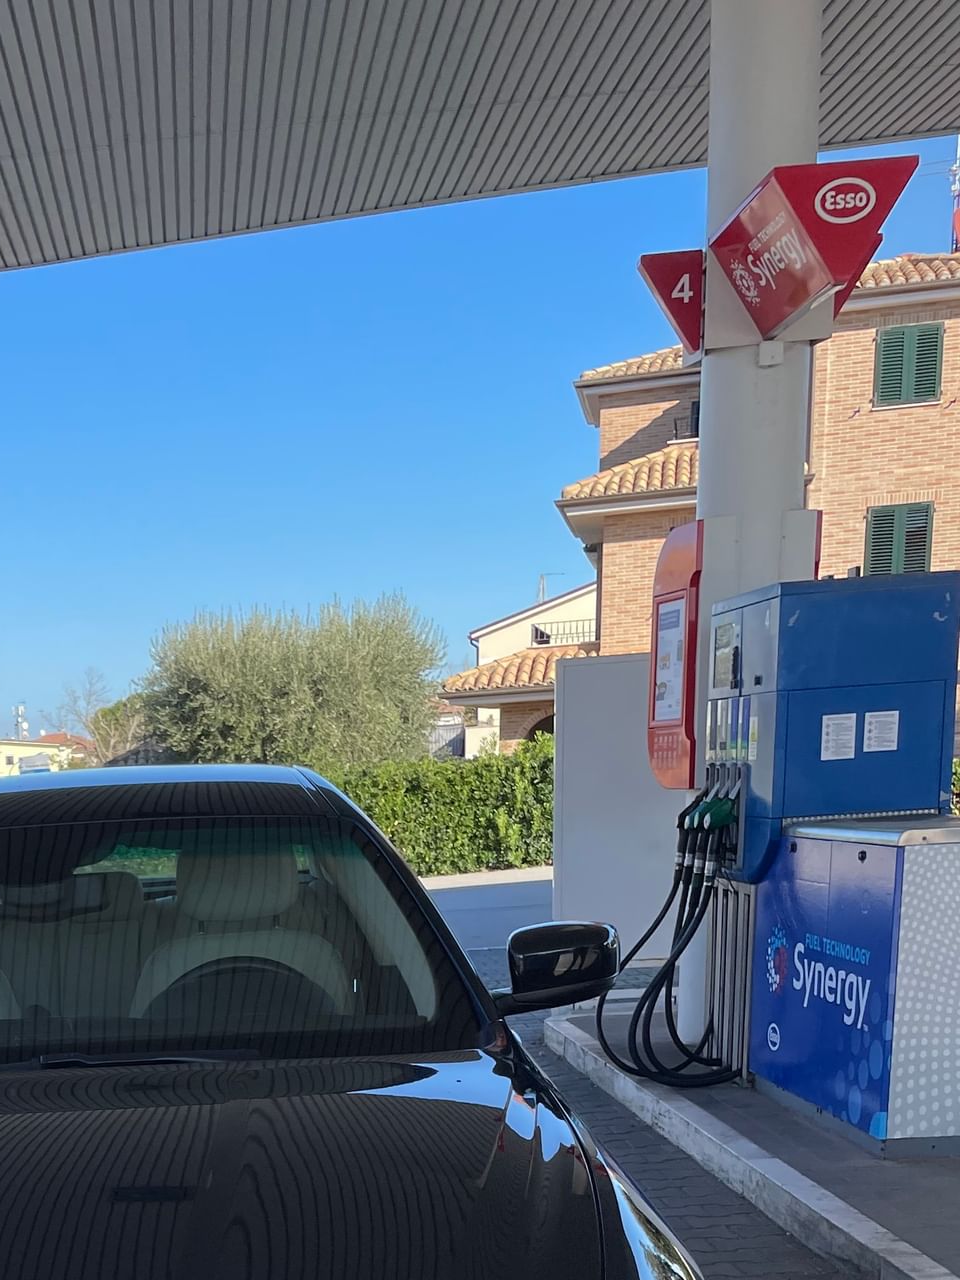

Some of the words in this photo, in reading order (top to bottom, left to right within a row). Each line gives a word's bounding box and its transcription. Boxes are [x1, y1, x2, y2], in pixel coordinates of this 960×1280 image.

[825, 190, 867, 210] Esso
[747, 228, 807, 290] Synergy
[671, 273, 693, 303] 4
[805, 933, 821, 952] FUEL
[822, 937, 871, 966] TECHNOLOGY
[792, 942, 871, 1030] Synergy
